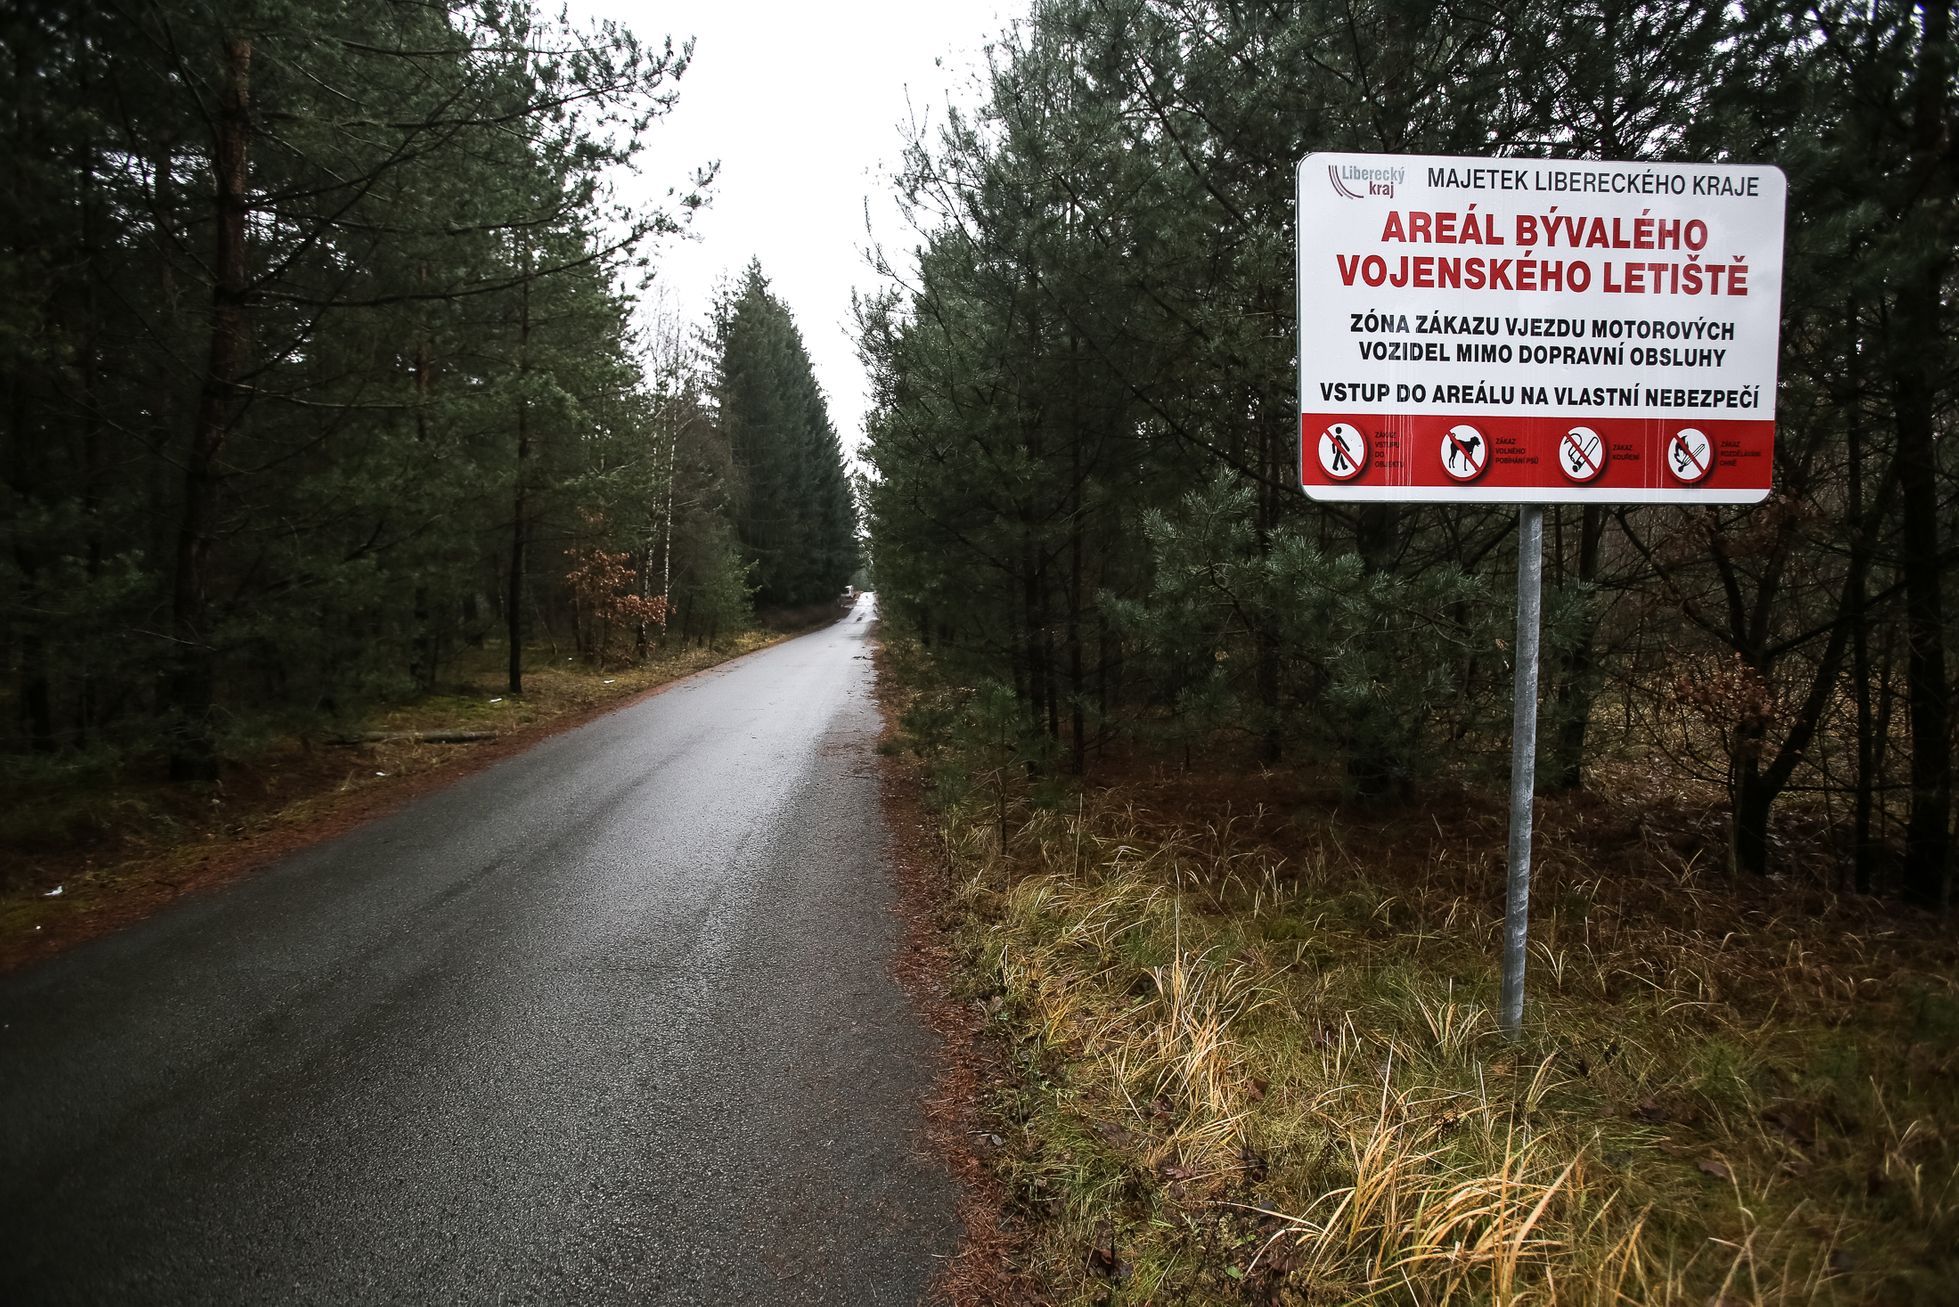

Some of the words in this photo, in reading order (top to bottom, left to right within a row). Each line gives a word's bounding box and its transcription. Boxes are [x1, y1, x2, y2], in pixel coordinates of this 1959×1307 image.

[1341, 165, 1404, 185] Liberecký
[1429, 168, 1528, 190] MAJETEK
[1536, 169, 1685, 195] LIBERECKÉHO
[1693, 176, 1759, 196] KRAJE
[1370, 181, 1393, 199] kraj
[1381, 204, 1504, 245] AREÁL
[1516, 206, 1707, 251] BÝVALÉHO
[1337, 250, 1591, 293] VOJENSKÉHO
[1604, 254, 1748, 296] LETIŠTĚ
[1351, 311, 1409, 333] ZÓNA
[1416, 312, 1499, 335] ZÁKAZU
[1505, 318, 1585, 337] VJEZDU
[1592, 317, 1734, 340] MOTOROVÝCH
[1359, 342, 1450, 361] VOZIDEL
[1457, 344, 1512, 363] MIMO
[1519, 342, 1624, 365] DOPRAVNÍ
[1630, 347, 1726, 367] OBSLUHY
[1320, 383, 1390, 402] VSTUP
[1397, 384, 1426, 402] DO
[1432, 380, 1514, 404] AREÁLU
[1521, 387, 1548, 404] NA
[1554, 383, 1640, 406] VLASTNÍ
[1646, 385, 1759, 408] NEBEZPEČÍ
